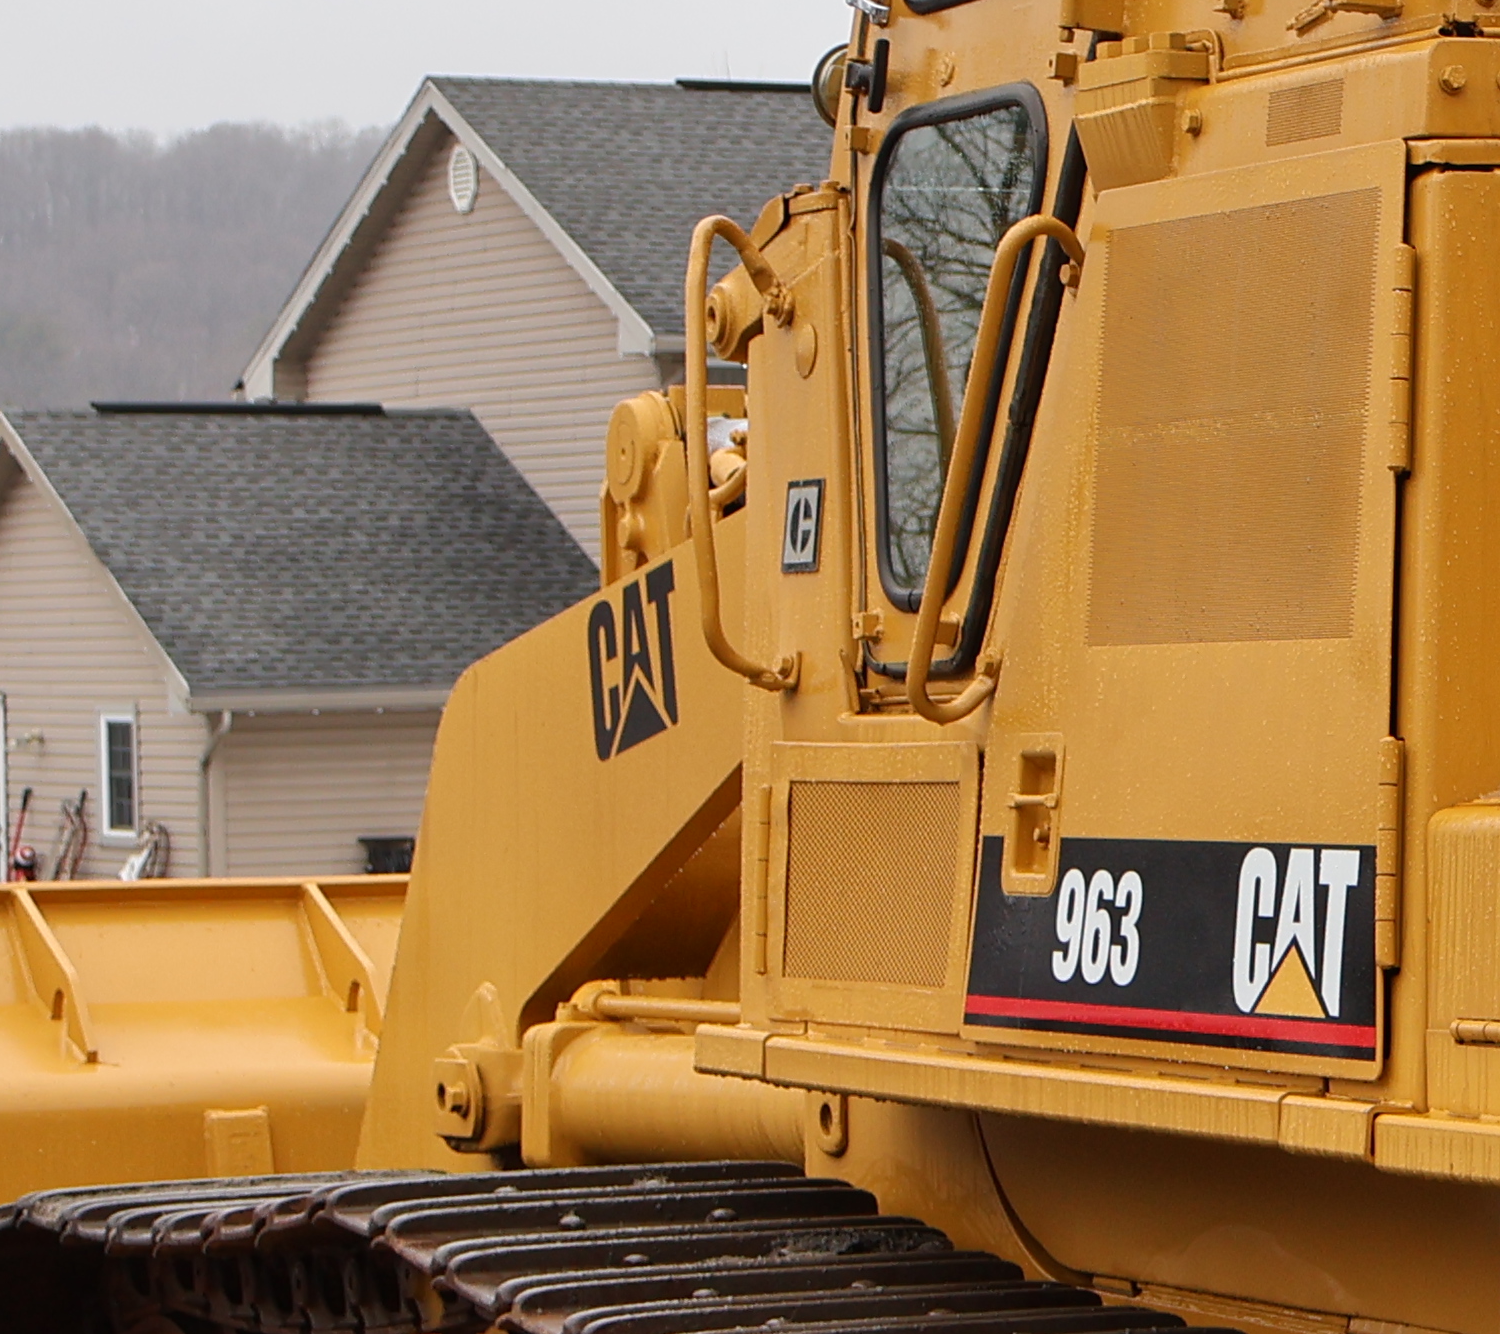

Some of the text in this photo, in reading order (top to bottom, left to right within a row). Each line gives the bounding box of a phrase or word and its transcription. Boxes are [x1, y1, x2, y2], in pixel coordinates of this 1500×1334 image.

[588, 560, 678, 761] CAT
[1052, 847, 1360, 1017] 963 CAT
